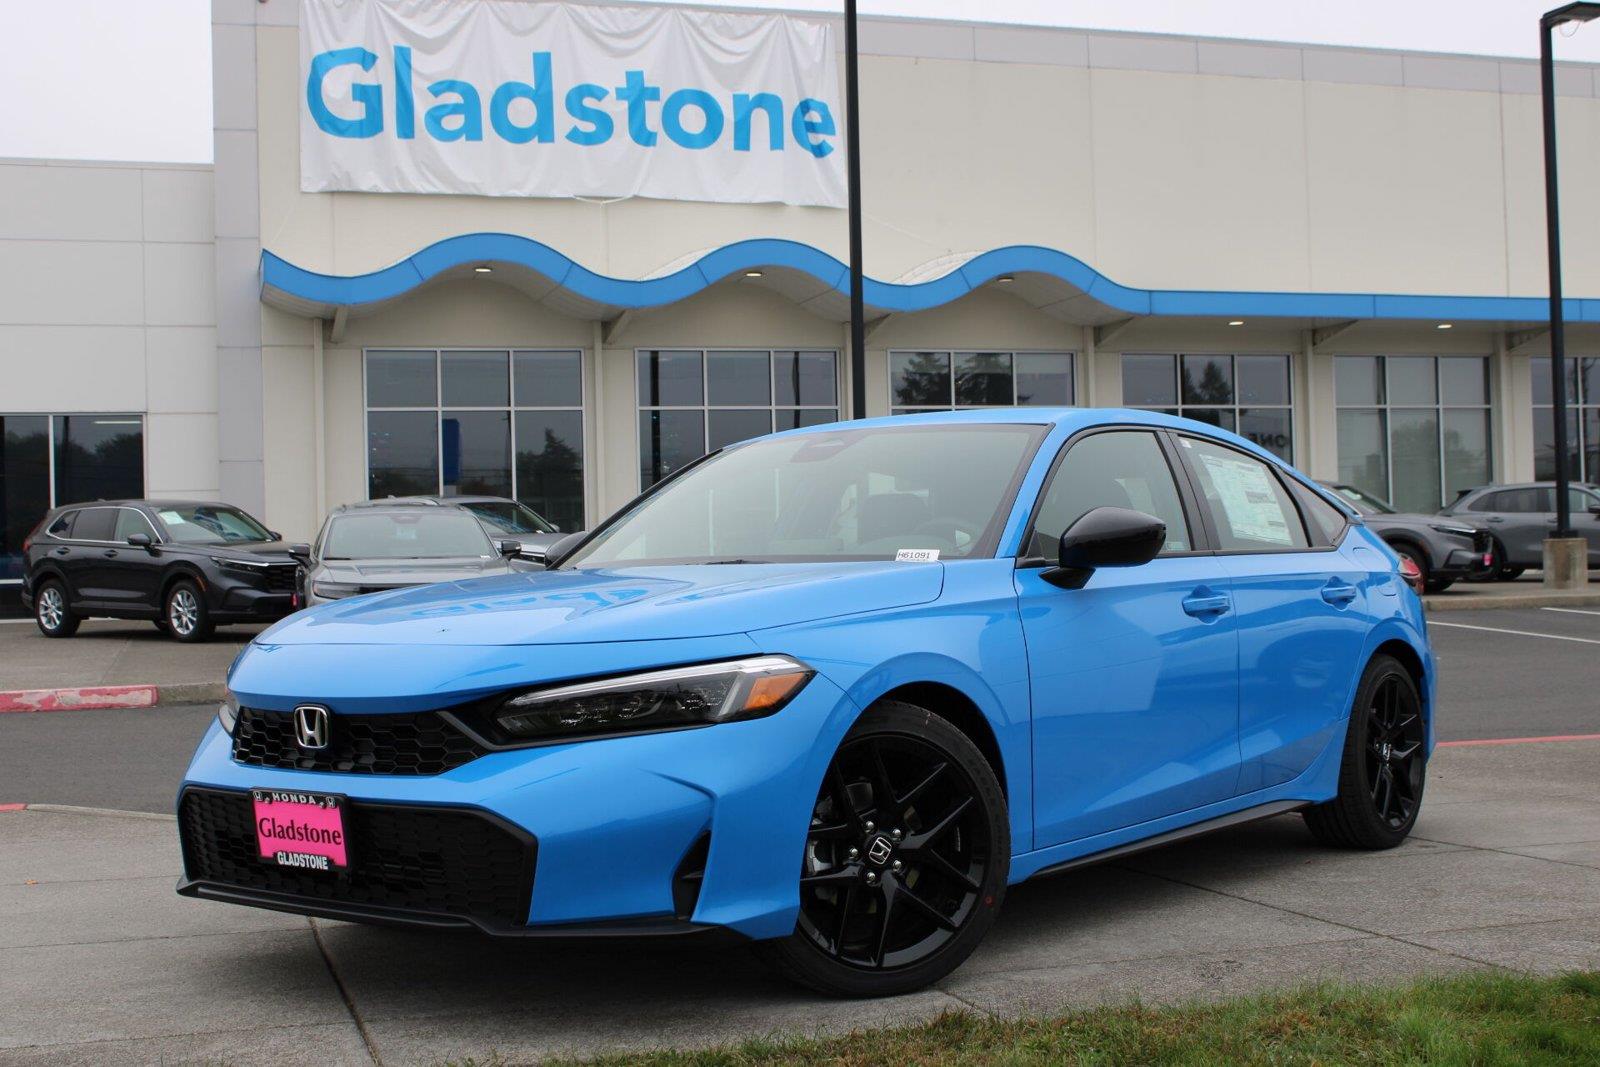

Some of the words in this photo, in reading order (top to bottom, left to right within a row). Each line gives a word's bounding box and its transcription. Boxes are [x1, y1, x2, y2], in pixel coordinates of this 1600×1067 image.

[306, 45, 837, 159] Gladstone
[272, 792, 316, 805] HONDA
[259, 817, 342, 846] Gladstone
[277, 851, 329, 870] GLADSTONE
